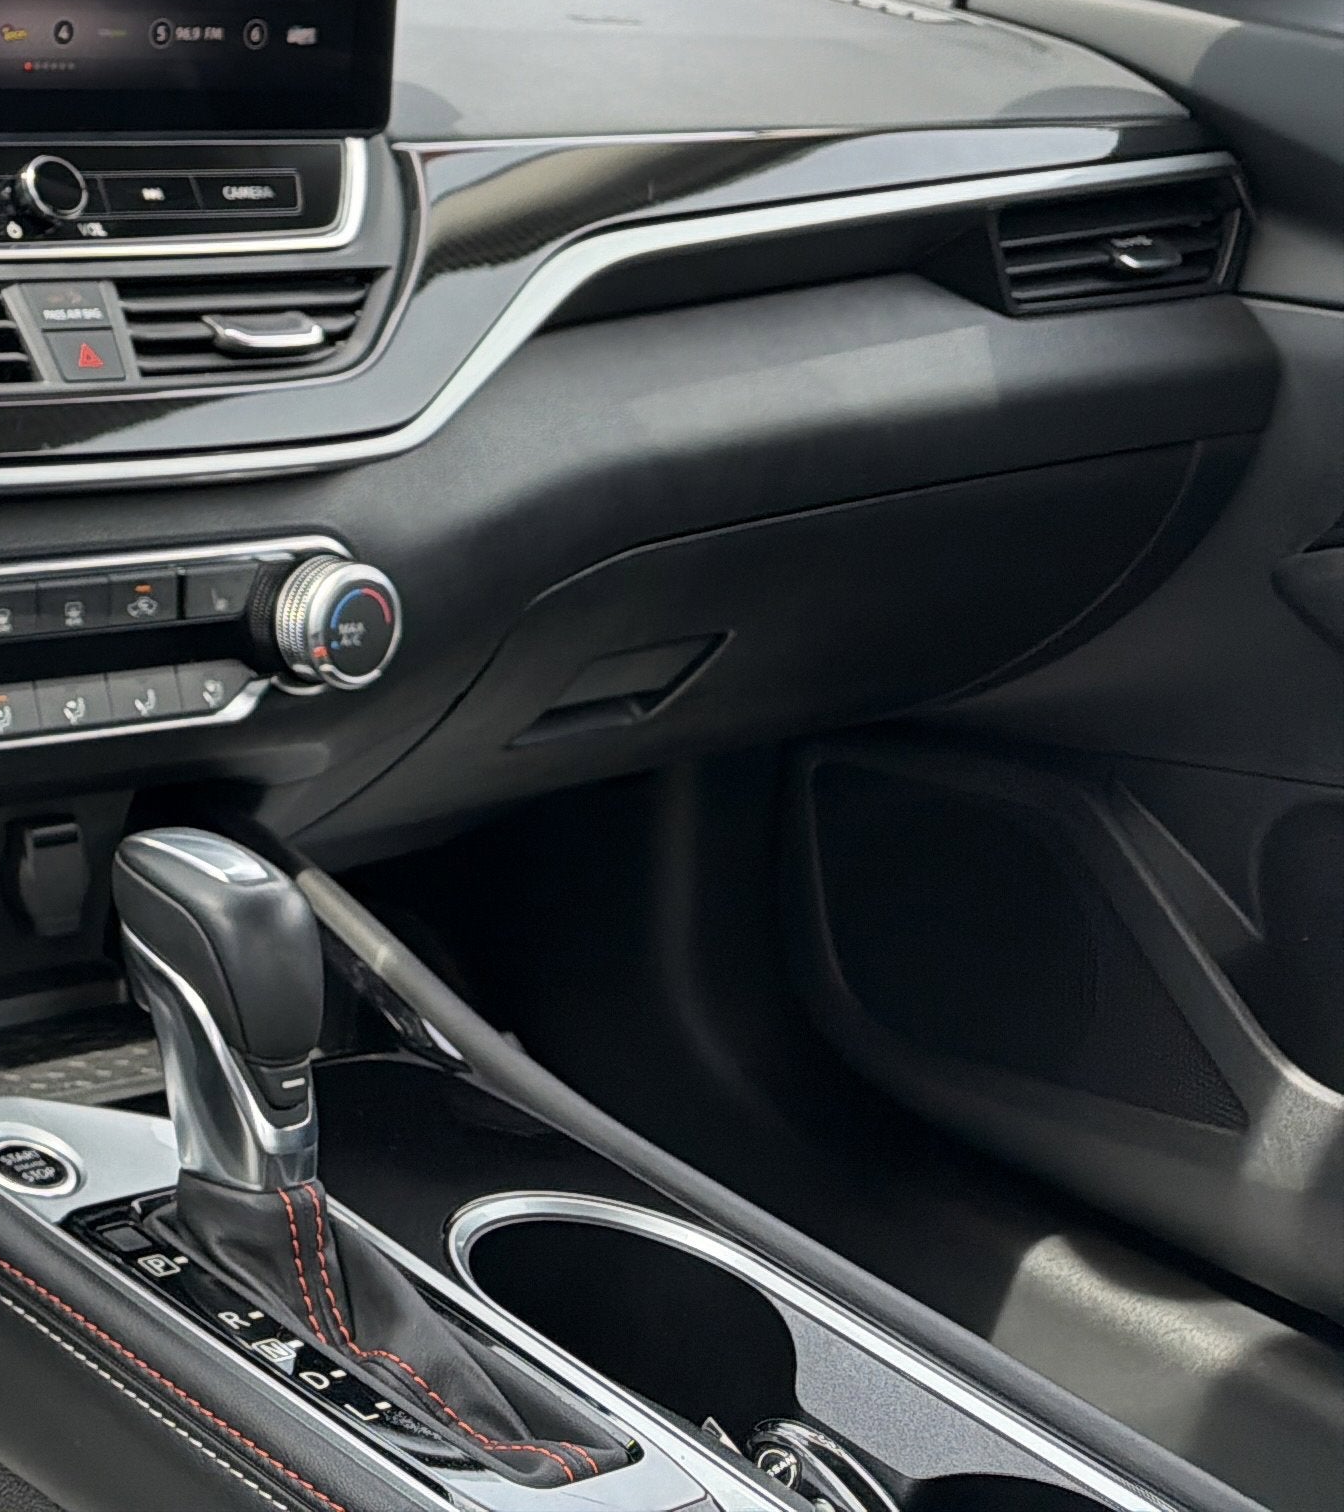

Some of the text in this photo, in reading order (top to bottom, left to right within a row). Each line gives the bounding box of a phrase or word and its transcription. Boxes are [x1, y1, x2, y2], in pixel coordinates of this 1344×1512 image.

[218, 1312, 251, 1330] R
[299, 1371, 330, 1390] D
[344, 1403, 379, 1420] L
